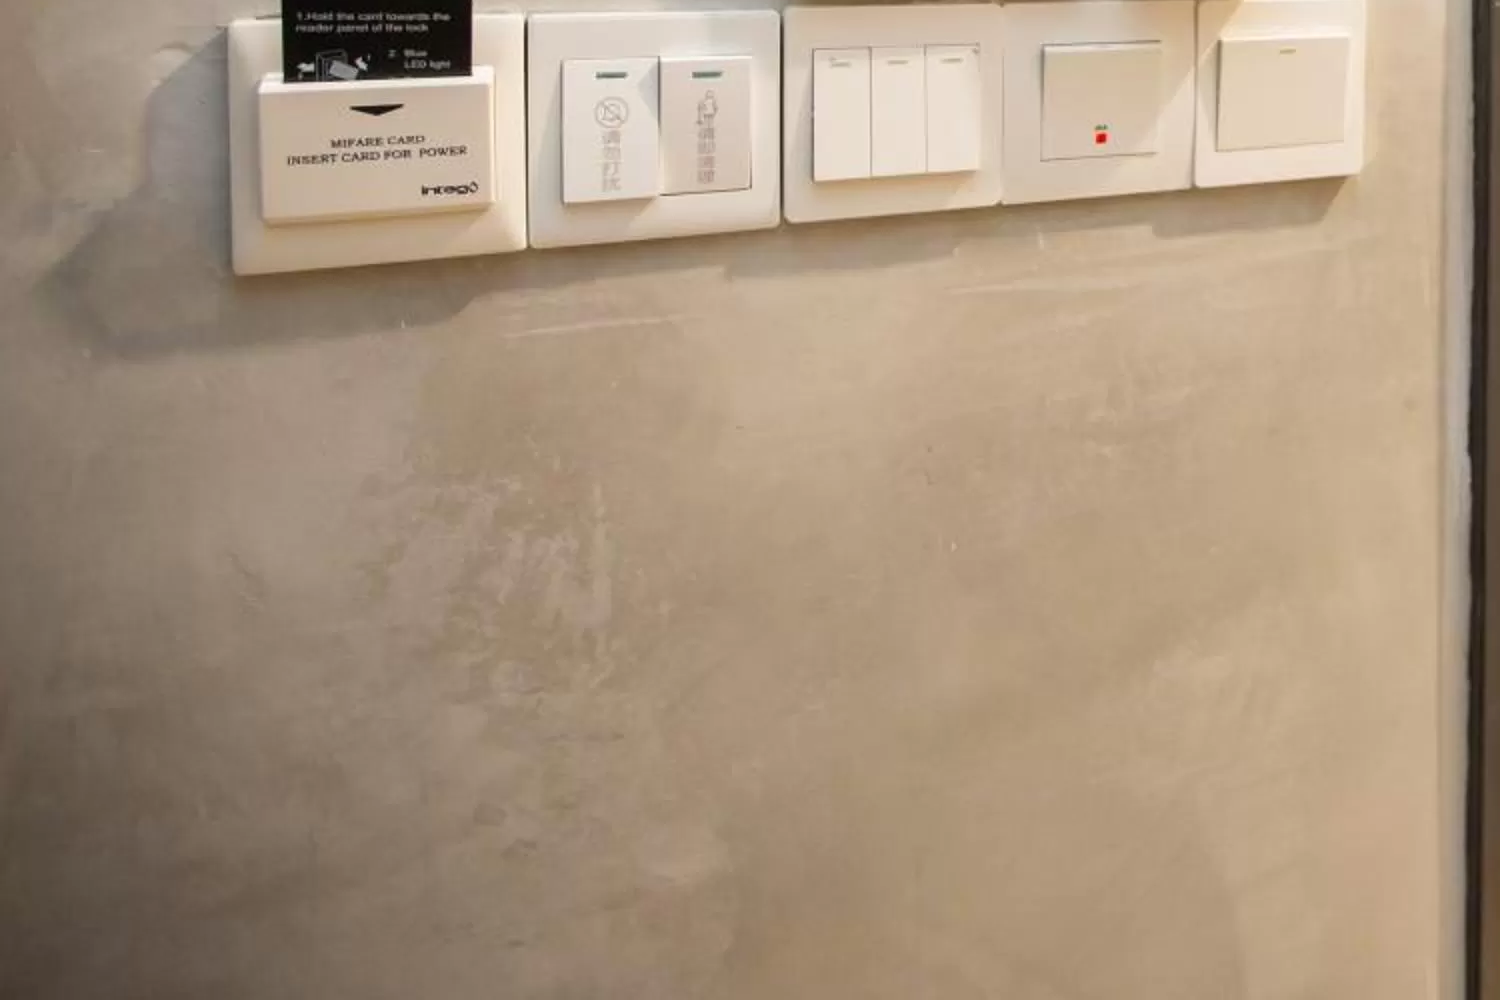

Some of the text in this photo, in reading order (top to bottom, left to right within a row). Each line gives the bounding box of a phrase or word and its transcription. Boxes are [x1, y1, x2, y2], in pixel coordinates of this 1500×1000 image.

[336, 11, 355, 21] the
[357, 11, 383, 21] card
[385, 12, 430, 21] towards
[432, 11, 451, 21] the
[296, 23, 428, 34] reader panel of the lock
[403, 60, 427, 69] LED
[330, 135, 425, 148] MIFARE CARD
[287, 145, 468, 165] INSERT CARD FOR POWER
